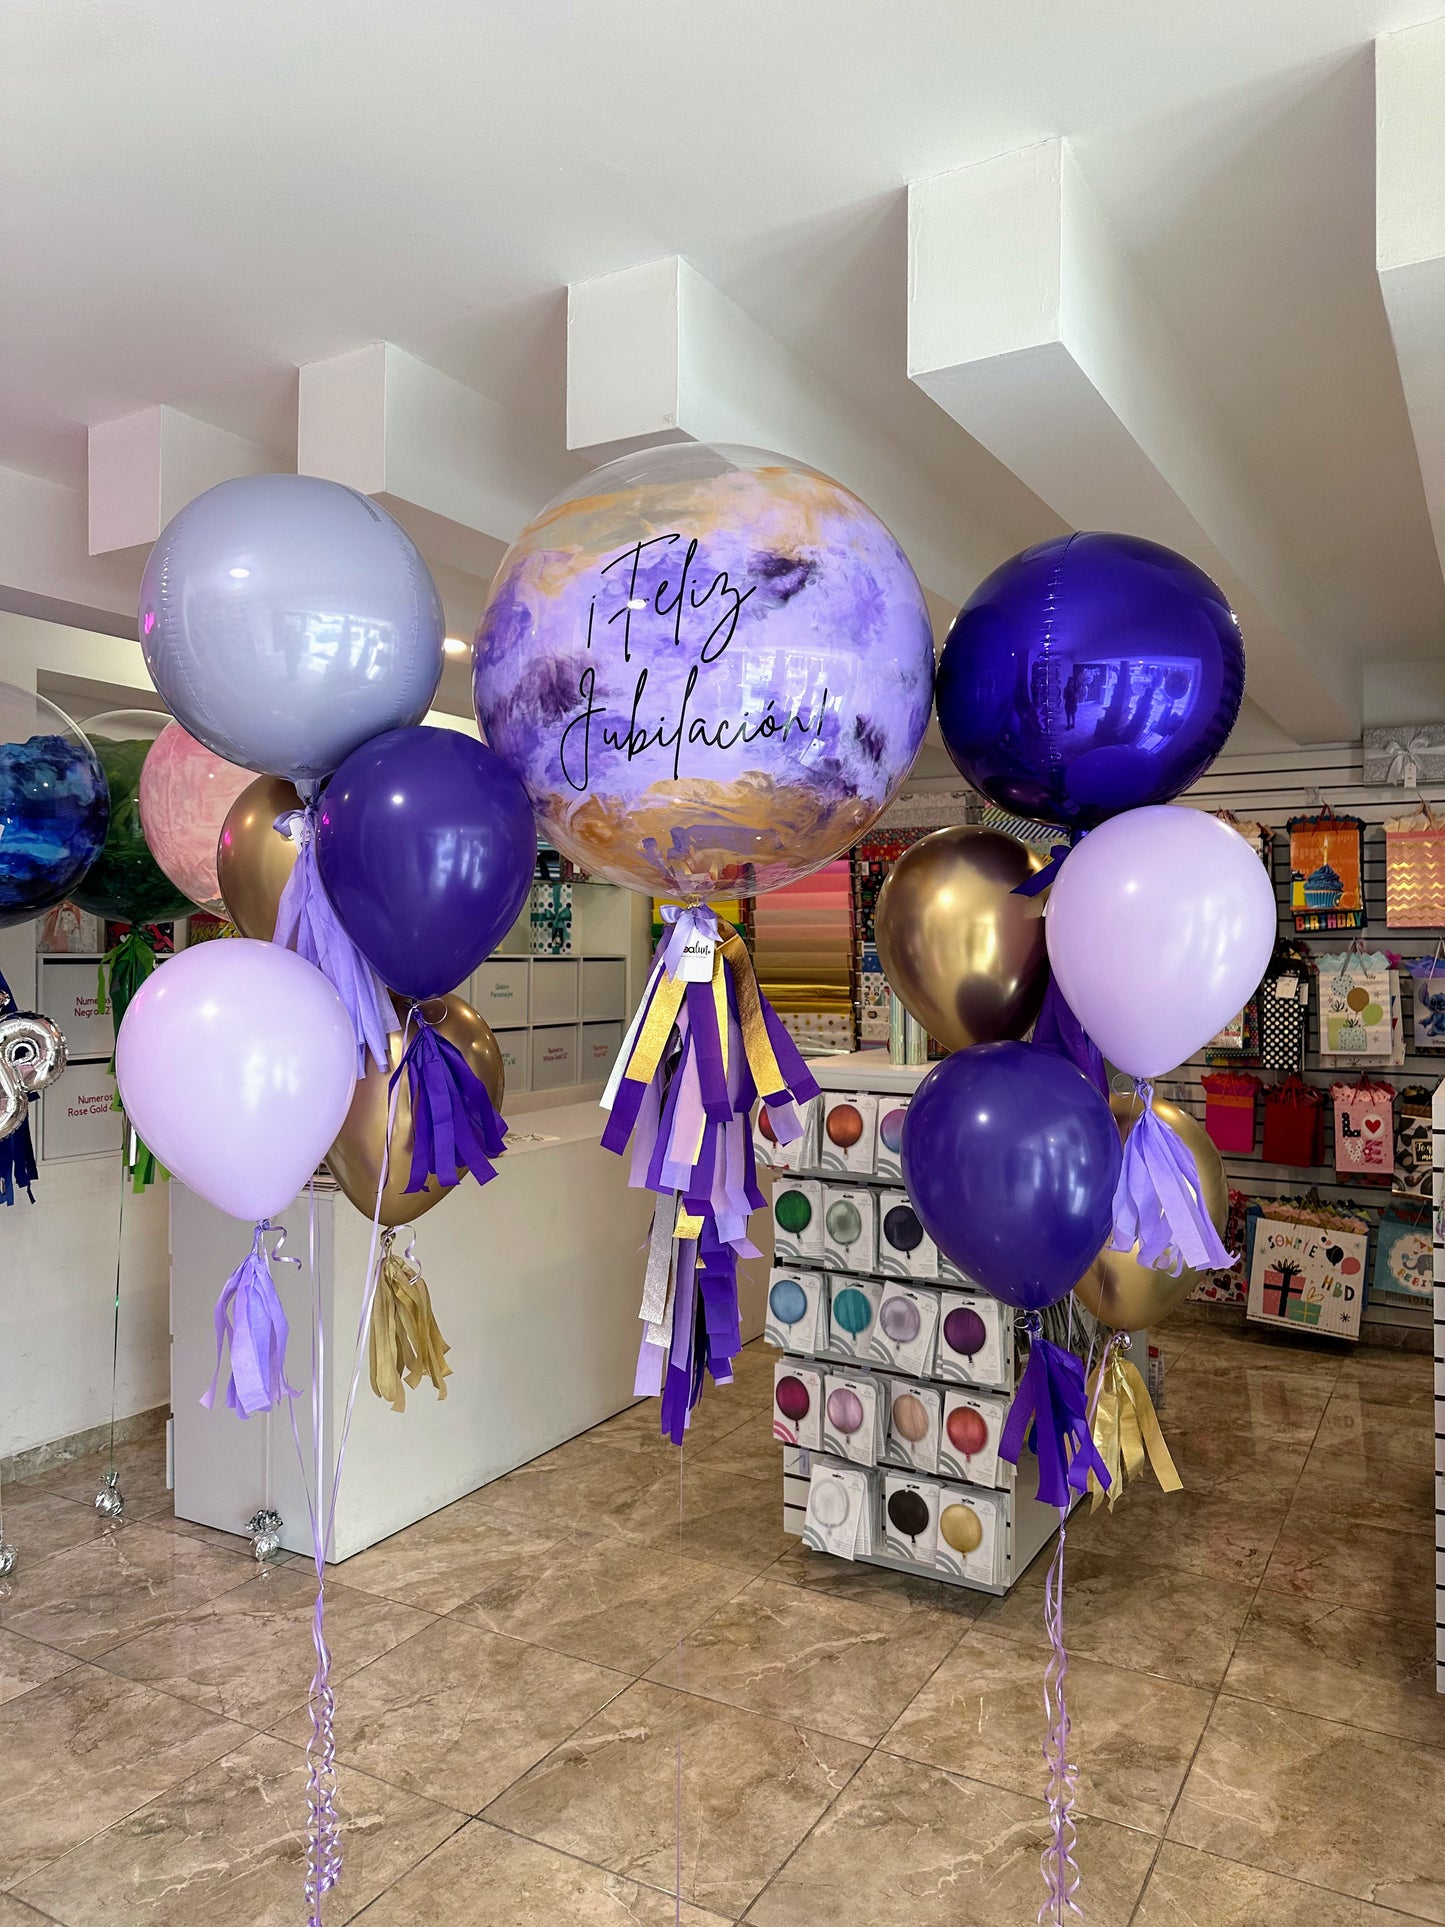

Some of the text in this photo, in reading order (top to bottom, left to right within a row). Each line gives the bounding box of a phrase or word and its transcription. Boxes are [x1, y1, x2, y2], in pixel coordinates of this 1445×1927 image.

[560, 665, 828, 792] Jubilación!
[1295, 912, 1363, 931] BIRTHDAY
[77, 1094, 113, 1104] Numeros
[67, 1107, 88, 1117] Rose
[90, 1104, 107, 1114] Gold
[1321, 1274, 1355, 1302] HBD
